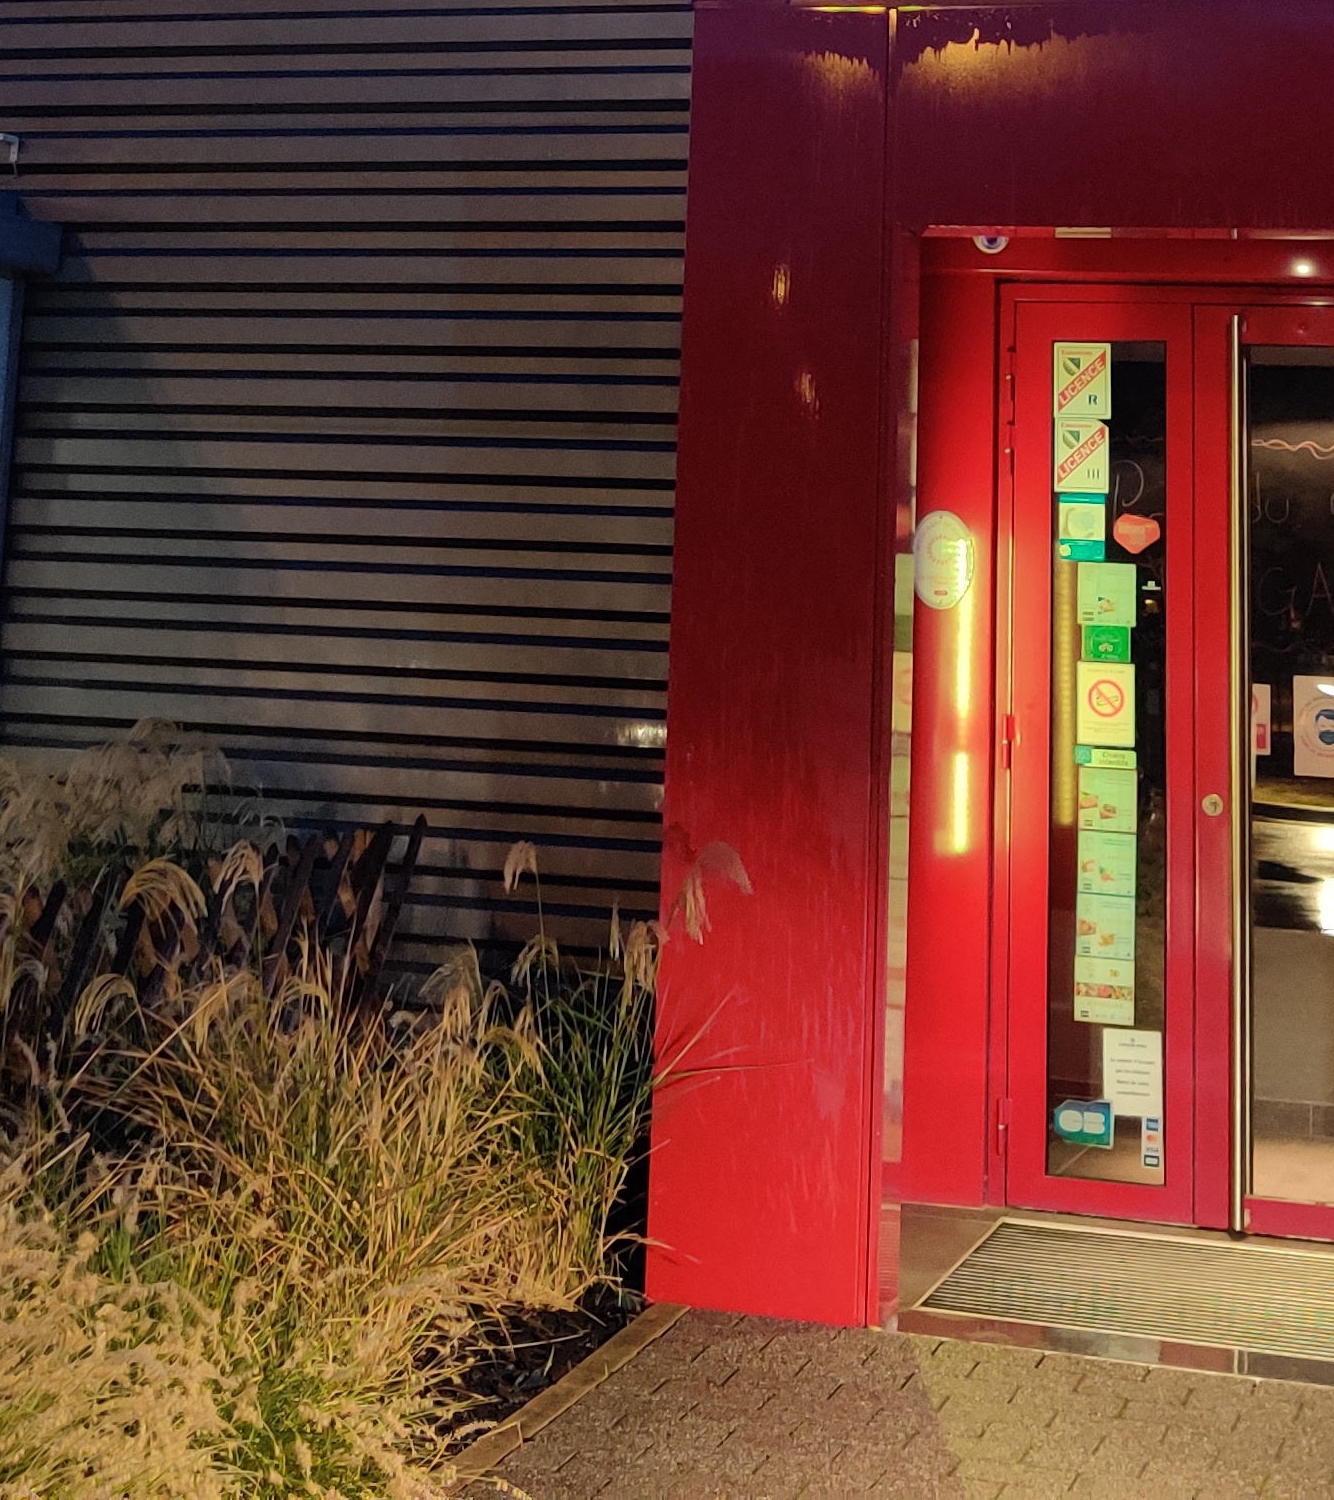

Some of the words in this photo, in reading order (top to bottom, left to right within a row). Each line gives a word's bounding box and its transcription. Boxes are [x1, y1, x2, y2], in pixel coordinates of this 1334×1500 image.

[1058, 357, 1105, 406] LICENCE
[1088, 394, 1098, 406] R
[1058, 431, 1105, 478] LICENCE
[1087, 468, 1100, 480] III
[1058, 1109, 1105, 1135] CB
